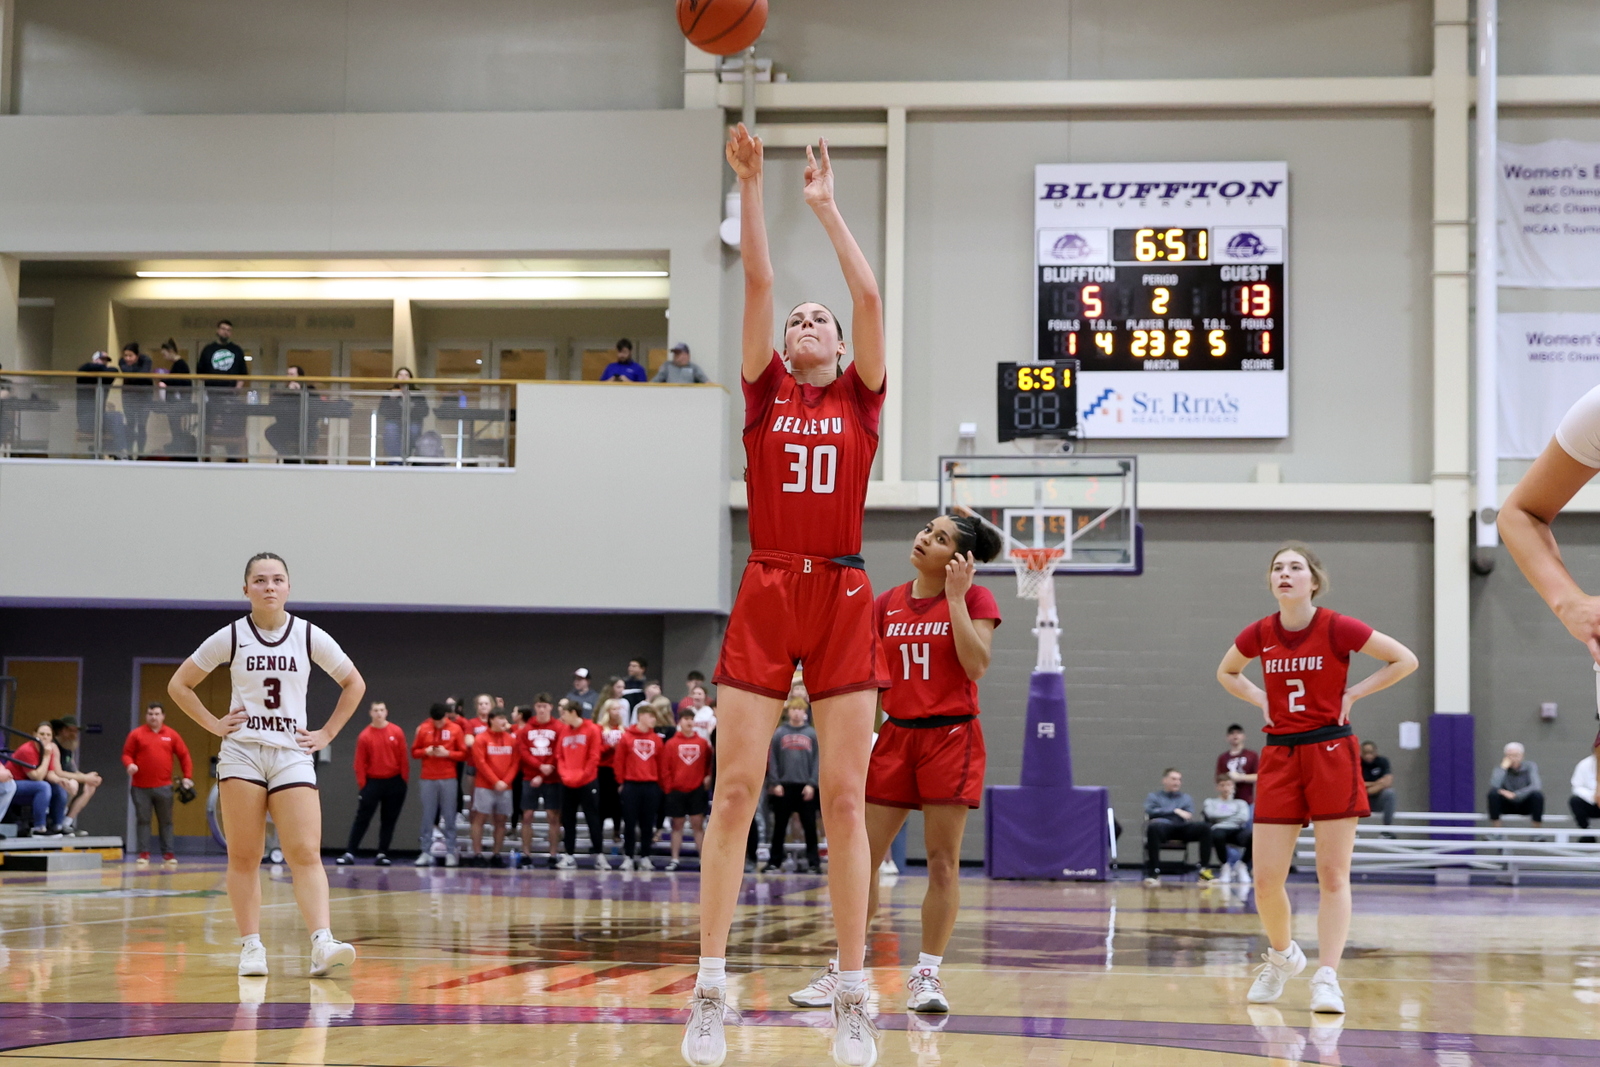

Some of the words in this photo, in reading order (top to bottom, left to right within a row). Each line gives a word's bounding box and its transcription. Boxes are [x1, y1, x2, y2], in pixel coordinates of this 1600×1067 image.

[1503, 163, 1588, 180] Women's
[1039, 180, 1283, 200] BLUFFTON
[1053, 200, 1255, 209] UNIVERSITY
[1135, 228, 1207, 262] 6:51
[1043, 266, 1116, 283] BLUFFTON
[1142, 273, 1179, 287] PERIOD
[1220, 265, 1269, 282] GUEST
[1082, 285, 1102, 318] 5
[1152, 287, 1170, 315] 2
[1241, 283, 1271, 317] 13
[1047, 319, 1081, 331] FOULS
[1126, 319, 1165, 331] PLAYER
[1168, 318, 1195, 331] FOUL
[1240, 318, 1275, 330] FOULS
[1068, 332, 1077, 356] 1
[1095, 332, 1113, 356] 4
[1131, 329, 1166, 358] 23
[1172, 329, 1191, 358] 2
[1208, 329, 1227, 358] 5
[1261, 331, 1271, 355] 1
[1143, 359, 1180, 371] MATCH
[1240, 359, 1275, 371] SCORE
[1017, 366, 1071, 391] 6:51
[771, 415, 844, 436] BELLEVU
[782, 443, 838, 494] 30
[802, 558, 812, 574] B
[885, 621, 950, 638] BELLEVUE
[246, 655, 298, 672] GENOA
[899, 642, 930, 681] 14
[1265, 655, 1324, 675] BELLEVUE
[262, 677, 281, 710] 3
[1285, 678, 1306, 713] 2
